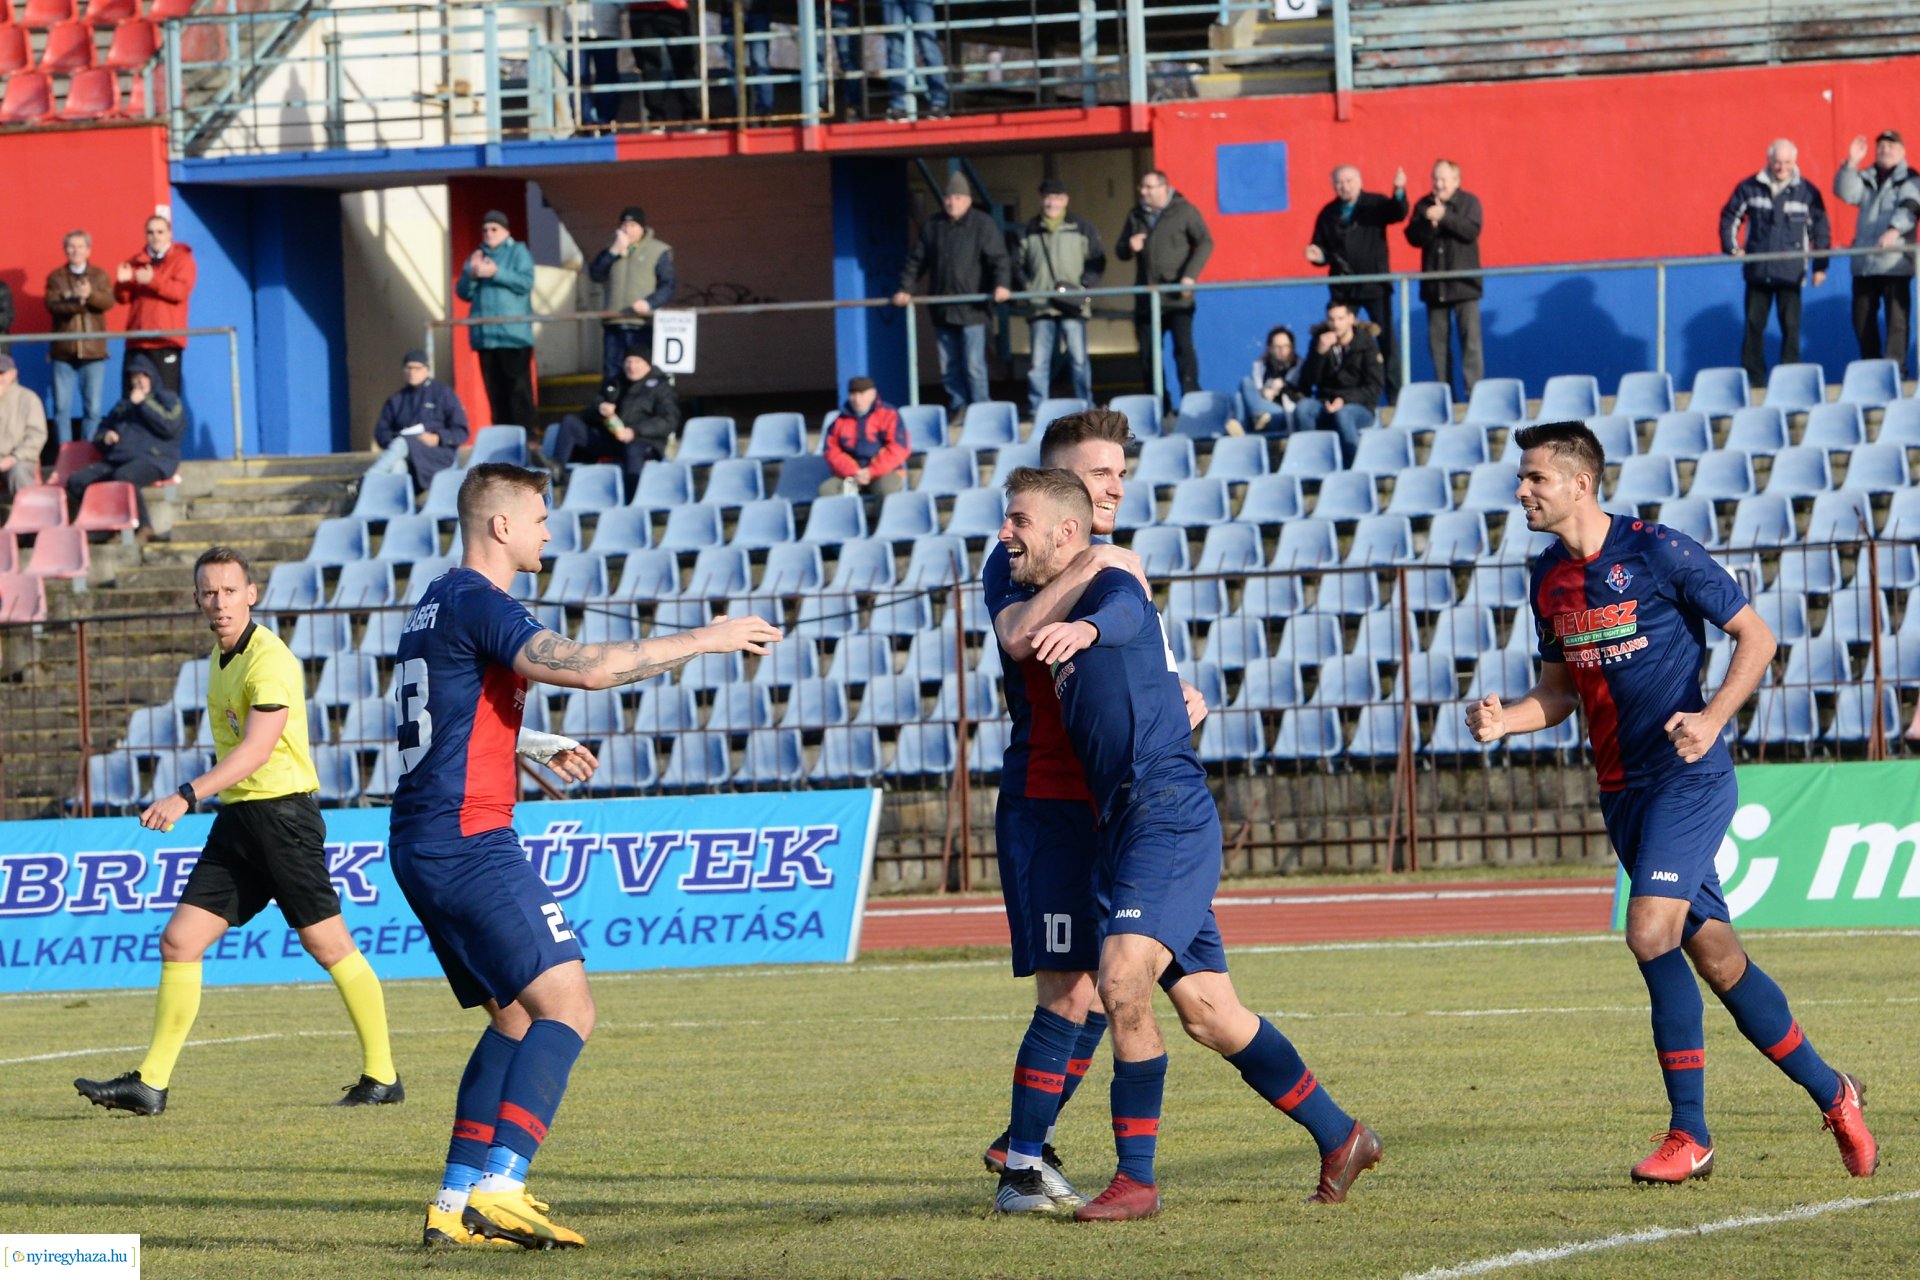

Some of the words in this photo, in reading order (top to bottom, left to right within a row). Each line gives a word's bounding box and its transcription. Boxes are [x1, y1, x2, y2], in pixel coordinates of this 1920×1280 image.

[665, 338, 683, 364] D
[1651, 870, 1679, 883] JAKO
[604, 904, 825, 947] GYÁRTÁSA
[1115, 908, 1142, 919] JAKO
[1043, 913, 1072, 953] 10
